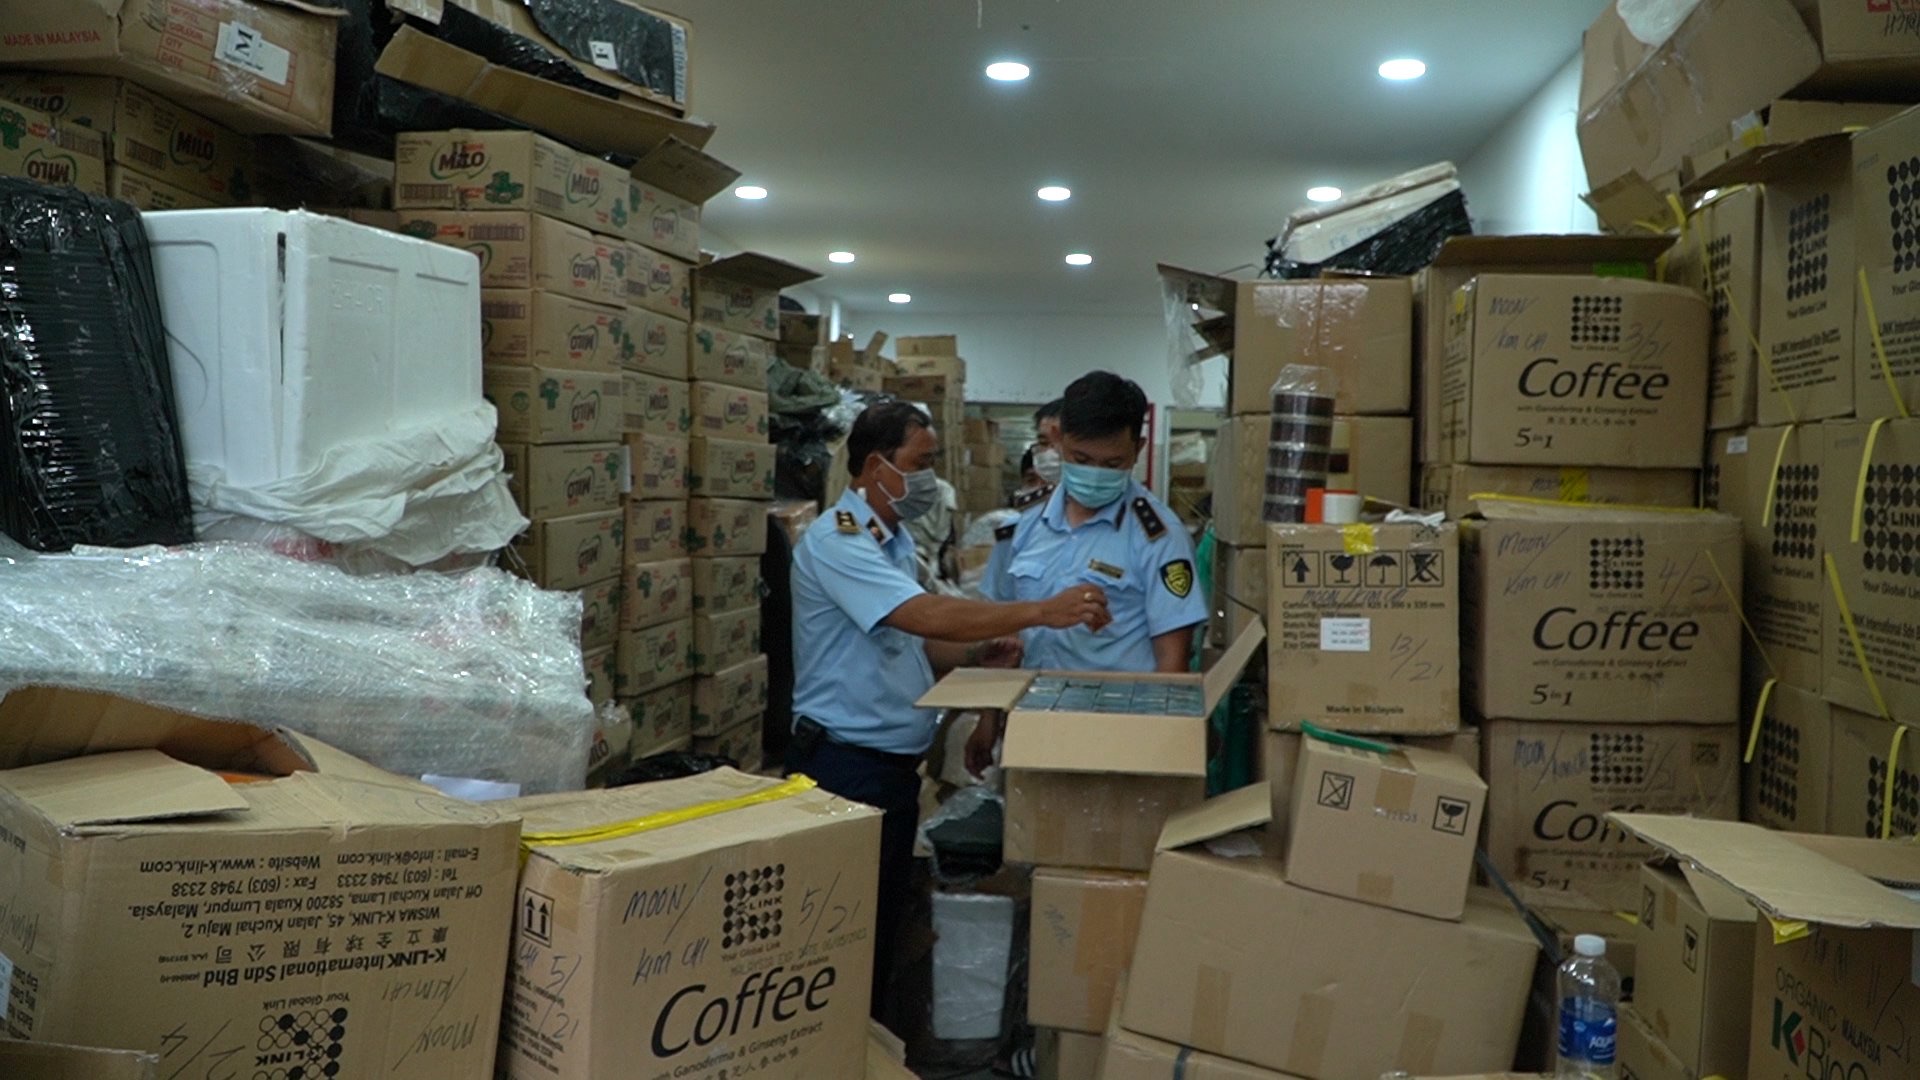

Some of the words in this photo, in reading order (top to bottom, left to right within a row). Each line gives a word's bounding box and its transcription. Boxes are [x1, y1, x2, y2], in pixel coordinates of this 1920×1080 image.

[3, 33, 33, 46] MADE
[46, 31, 100, 44] MALAYSIA
[177, 131, 215, 160] MILO
[27, 160, 70, 184] MILO
[571, 173, 599, 195] MILO
[1517, 358, 1670, 400] Coffee
[1533, 607, 1699, 651] Coffee
[1326, 705, 1351, 714] Made
[1364, 705, 1404, 715] Malaysia
[268, 855, 320, 870] Website
[337, 850, 434, 866] info@k-link.com
[444, 847, 480, 862] E-mail
[139, 858, 255, 874] www.k-link.com
[337, 874, 367, 888] 2333
[370, 872, 399, 886] 7948
[402, 868, 432, 884] (603)
[442, 868, 458, 881] Tel
[171, 882, 207, 897] 2338
[210, 880, 243, 894] 7948
[248, 876, 281, 893] (603)
[293, 877, 317, 890] Fax
[348, 892, 385, 905] Lama,
[388, 889, 430, 904] Kuchai
[433, 885, 464, 899] Jalan
[464, 885, 483, 899] Off
[203, 899, 261, 915] Lumpur,
[265, 897, 303, 913] Kuala
[306, 894, 344, 910] 58200
[128, 901, 199, 920] Malaysia.
[348, 910, 396, 925] K-LINK,
[399, 906, 440, 922] WISMA
[236, 918, 284, 936] Kuchai
[288, 915, 323, 931] Jalan
[327, 913, 345, 927] 45,
[181, 923, 194, 938] 2,
[197, 920, 232, 937] Maju
[386, 948, 447, 968] K-LINK
[244, 965, 277, 984] Sdn
[280, 957, 385, 981] International
[203, 969, 239, 988] Bhd
[262, 999, 286, 1011] Link
[288, 995, 323, 1007] Global
[326, 992, 350, 1003] Your
[1776, 967, 1836, 1032] ORGANIC
[651, 966, 836, 1059] Coffee
[673, 1051, 735, 1078] Ganoderma
[749, 1033, 788, 1054] Ginseng
